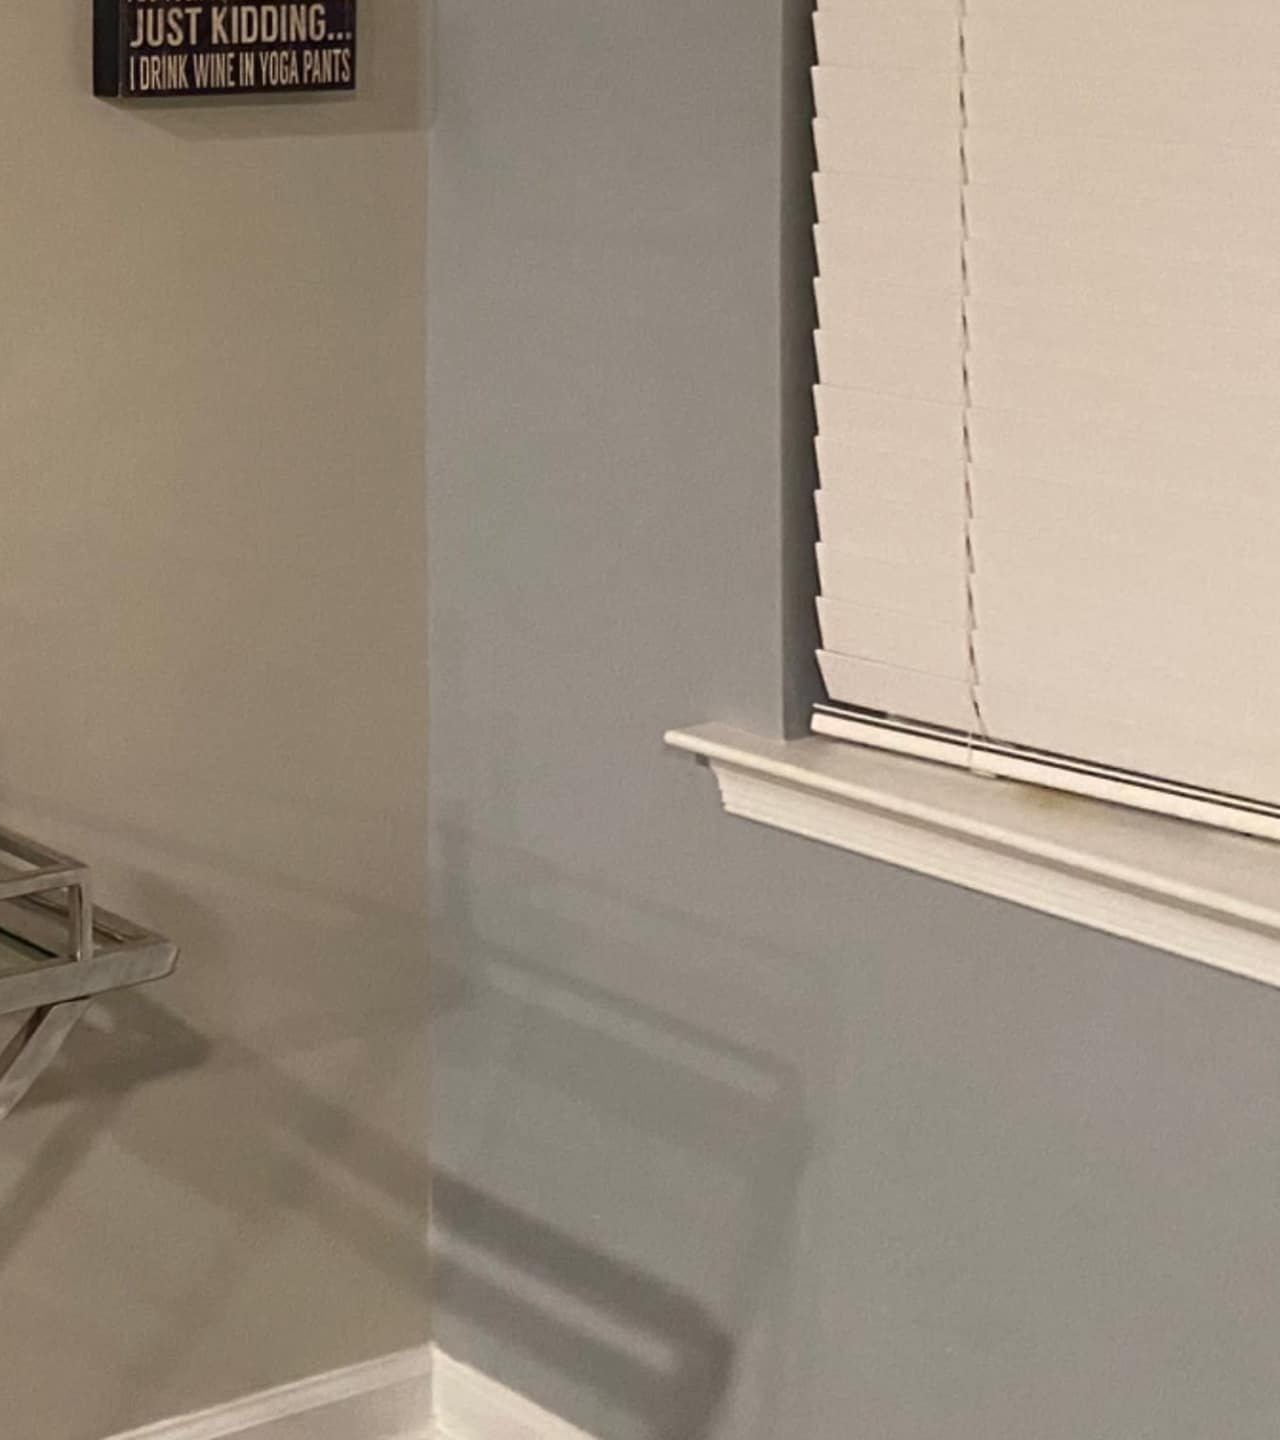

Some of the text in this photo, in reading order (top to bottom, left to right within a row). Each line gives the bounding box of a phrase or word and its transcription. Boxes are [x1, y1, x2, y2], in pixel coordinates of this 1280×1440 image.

[130, 4, 352, 47] JUST KIDDING...
[130, 48, 352, 91] I DRINK WINE IN YOGA PANTS
